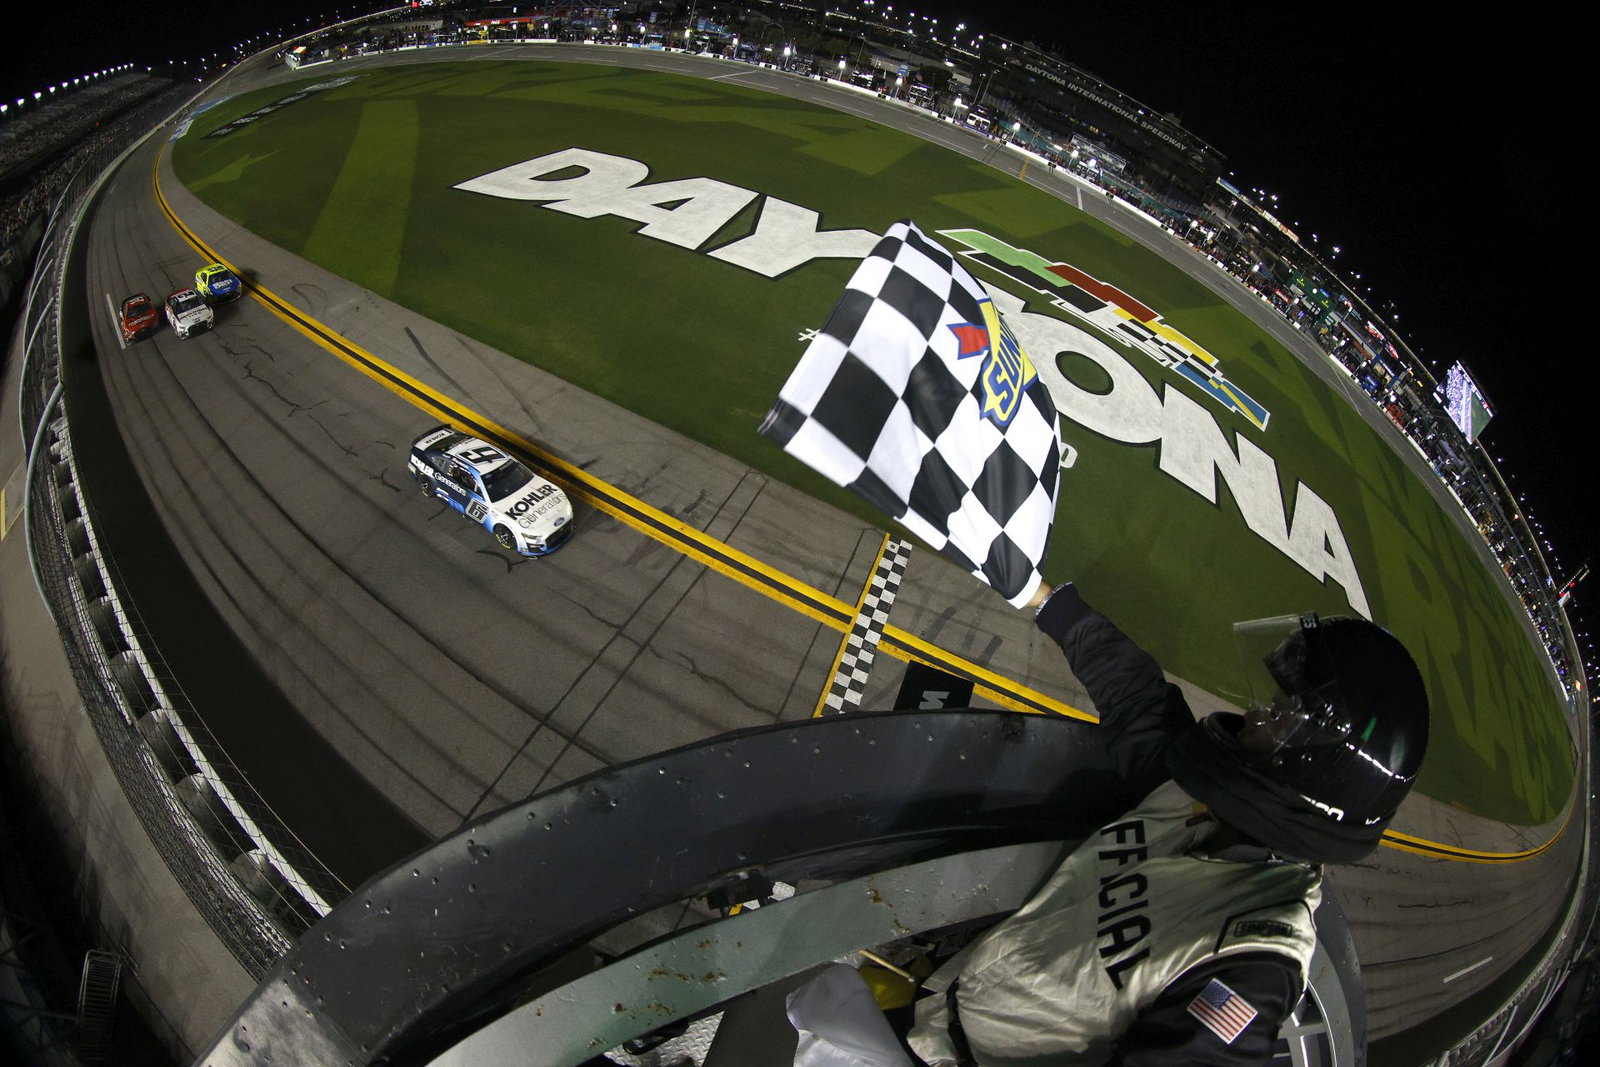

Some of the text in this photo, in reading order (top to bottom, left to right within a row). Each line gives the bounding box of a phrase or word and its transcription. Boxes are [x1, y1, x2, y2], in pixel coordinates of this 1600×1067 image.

[1025, 63, 1187, 151] DAYTONA INTERNATIONAL SPEEDWAY
[451, 147, 1373, 622] DAYONA
[987, 315, 1022, 415] SUN
[504, 484, 558, 520] KOHLER
[518, 493, 568, 530] Generators
[1097, 819, 1151, 991] FFICIAL
